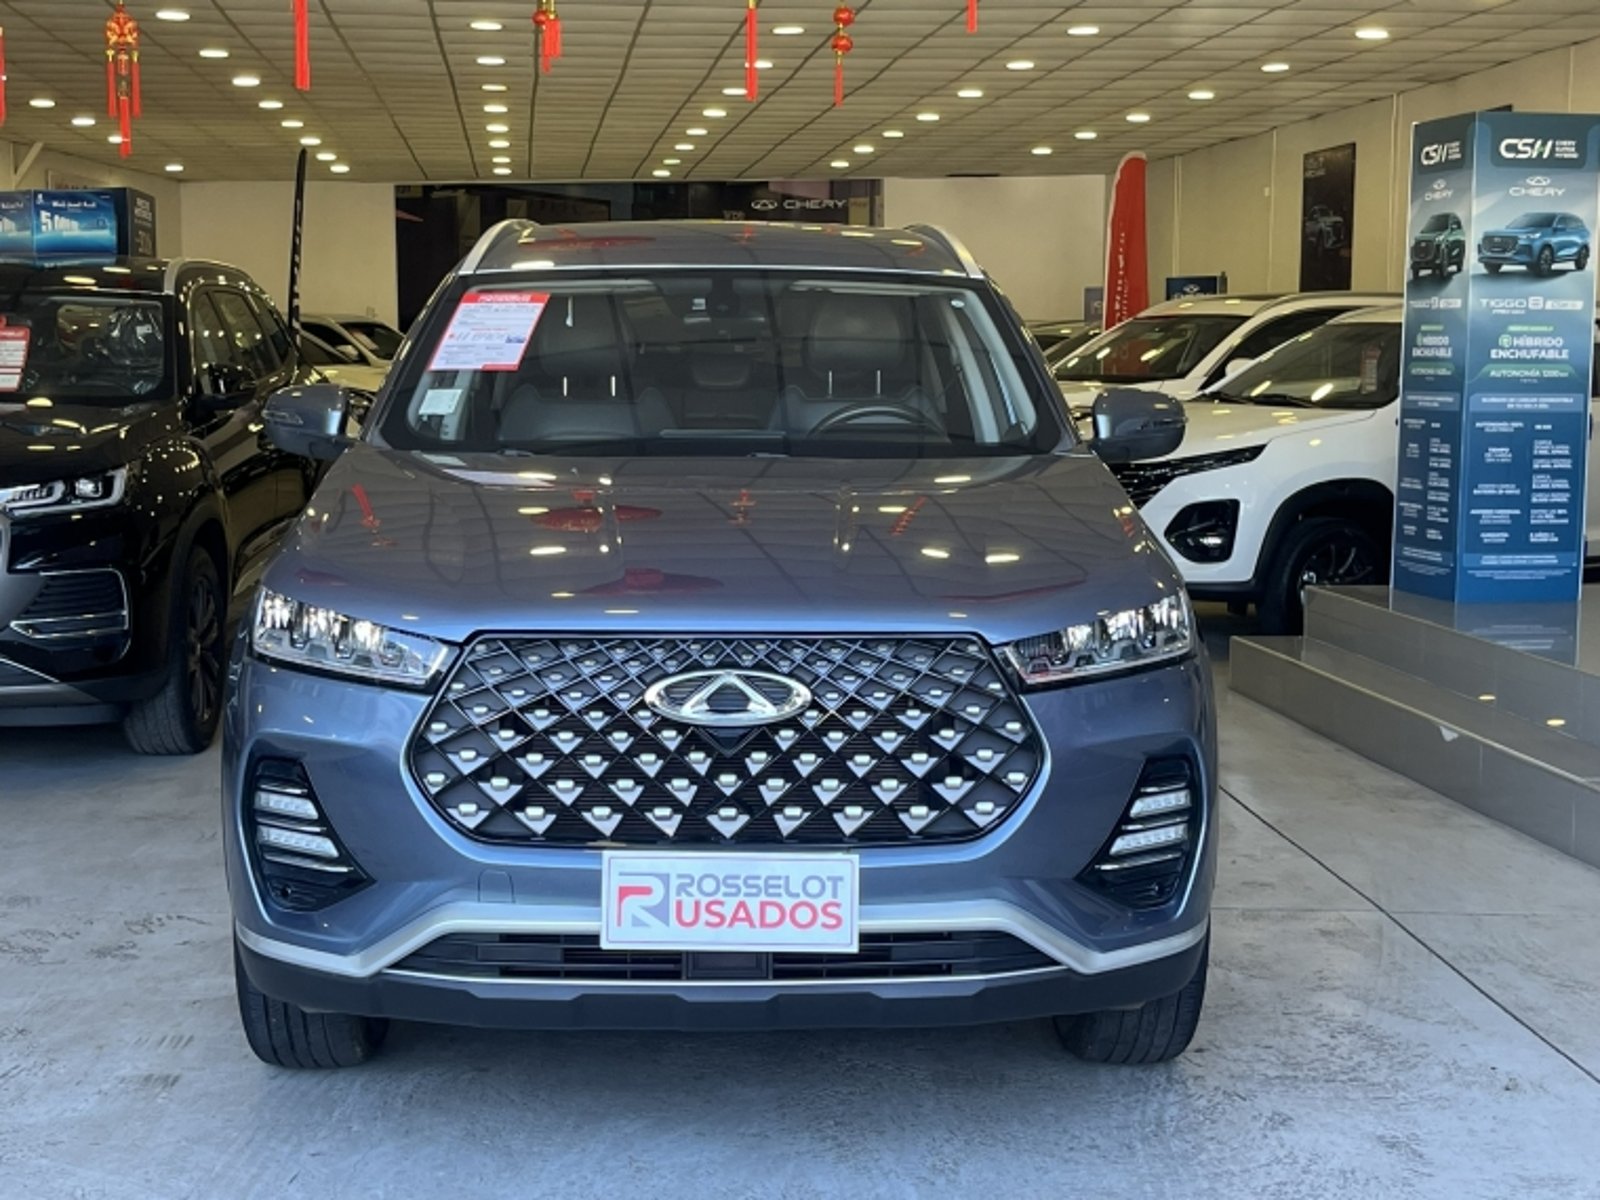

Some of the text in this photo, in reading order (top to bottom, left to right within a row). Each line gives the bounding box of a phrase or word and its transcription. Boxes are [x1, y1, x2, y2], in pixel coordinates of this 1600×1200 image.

[1499, 138, 1552, 158] CSH
[1509, 187, 1566, 197] CHERY
[782, 200, 847, 209] CHERY
[1480, 299, 1527, 308] TIGGO
[1513, 335, 1563, 347] HÍBRIDO
[1490, 349, 1569, 359] ENCHUFABLE
[676, 874, 844, 899] ROSSELOT
[675, 900, 843, 930] USADOS
